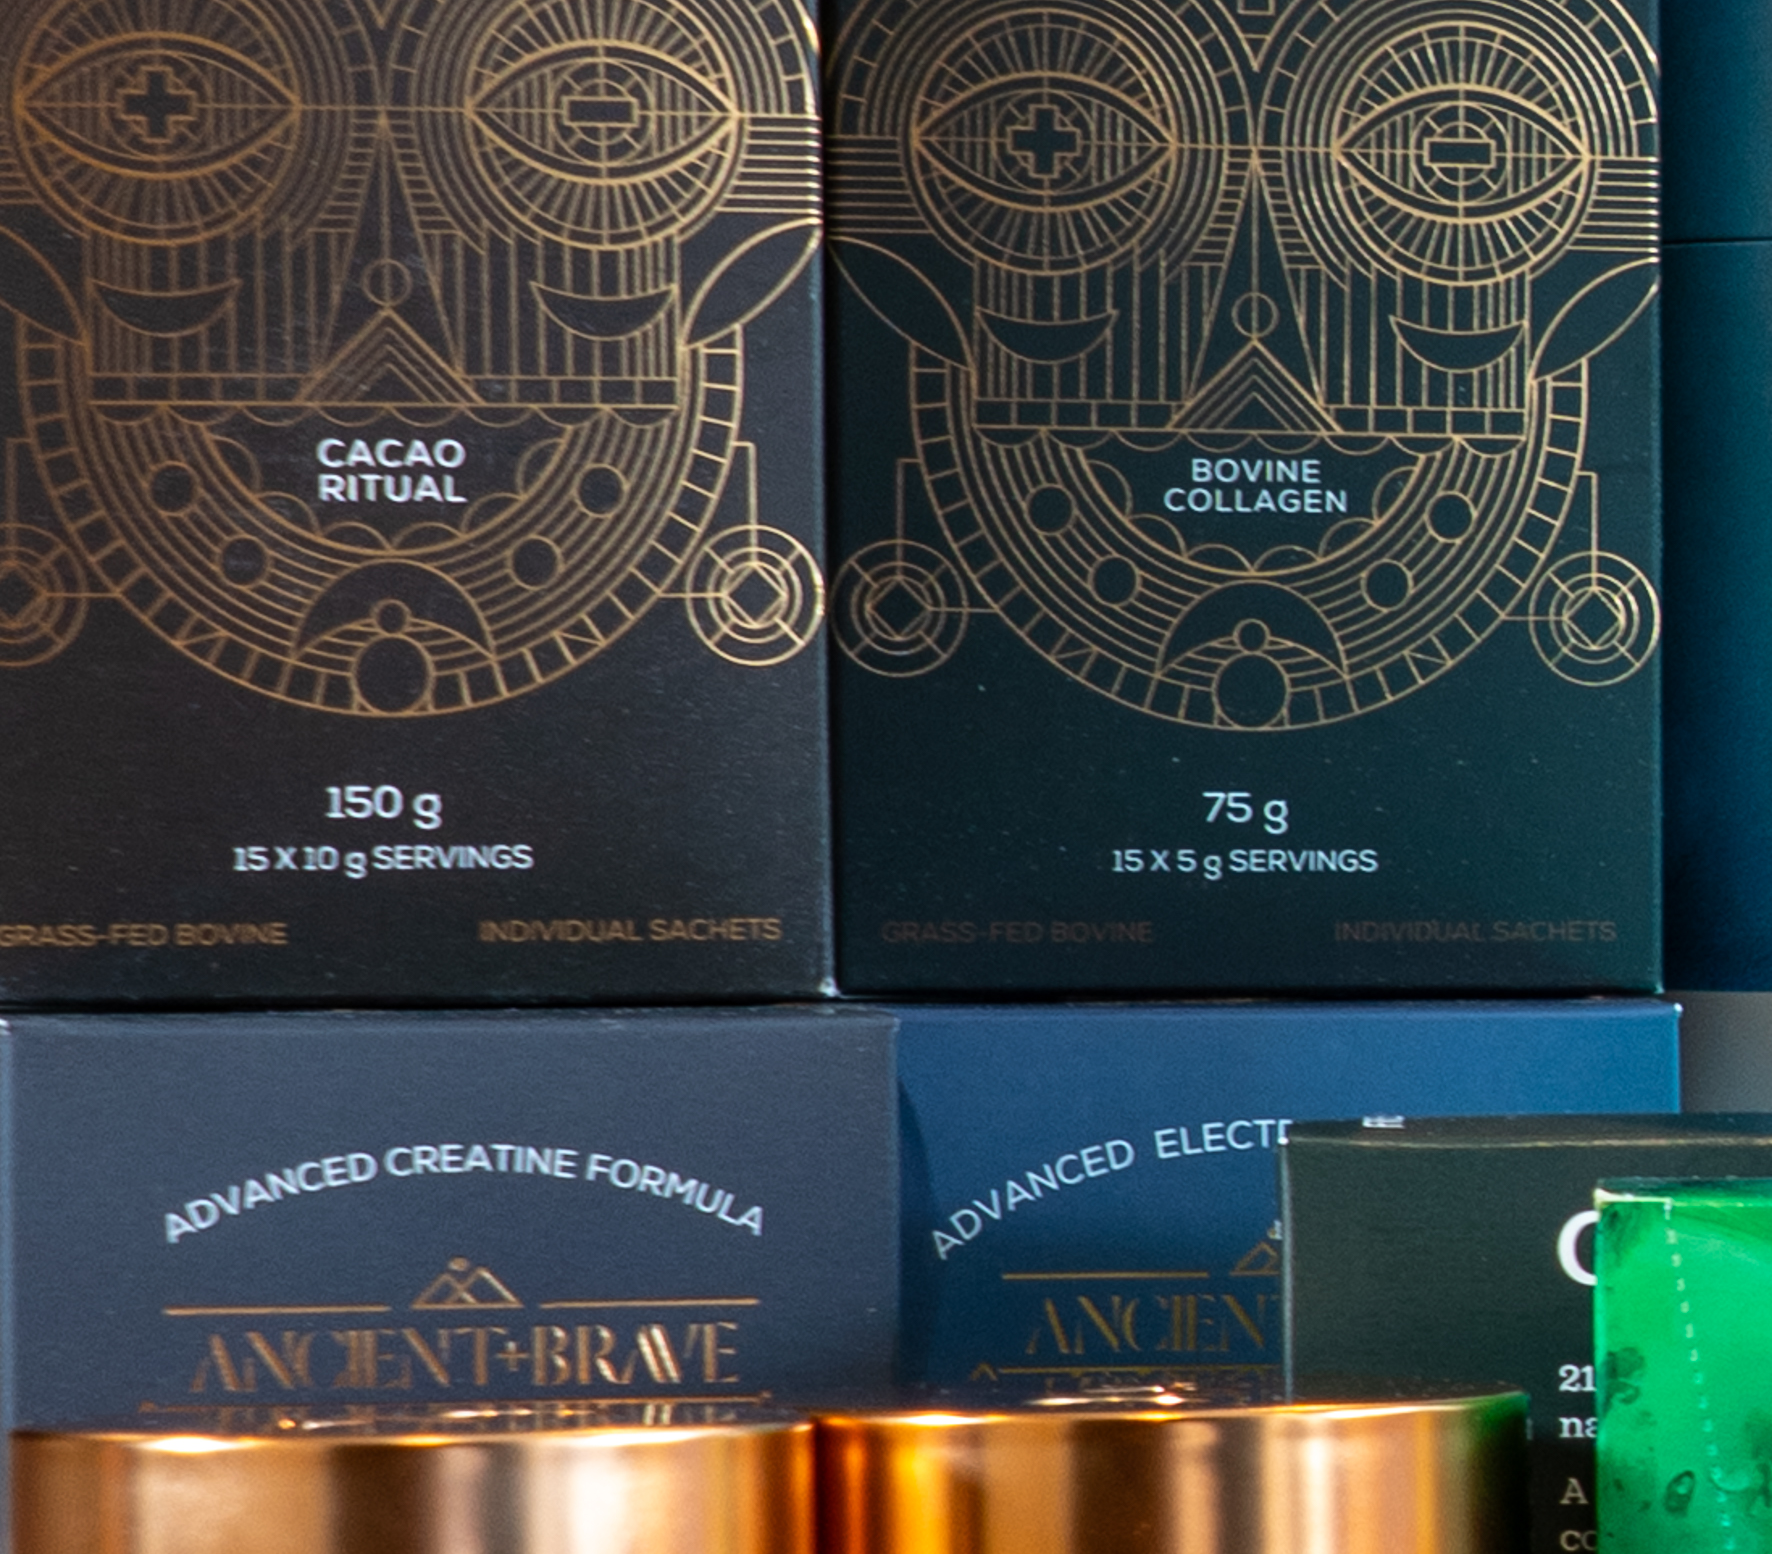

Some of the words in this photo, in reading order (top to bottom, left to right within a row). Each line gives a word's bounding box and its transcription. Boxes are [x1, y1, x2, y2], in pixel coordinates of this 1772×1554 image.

[317, 439, 466, 468] CACAO
[1191, 458, 1321, 484] BOVINE
[318, 474, 467, 504] RITUAL
[1163, 487, 1348, 514] COLLAGEN
[325, 785, 403, 821] 150
[1202, 791, 1253, 823] 75
[373, 845, 534, 871] SERVINGS
[1229, 849, 1378, 874] SERVINGS
[478, 918, 643, 944] INDIVIDUAL
[649, 916, 782, 943] SACHETS
[1335, 920, 1484, 944] INDIVIDUAL
[1495, 920, 1616, 944] SACHETS
[163, 1151, 378, 1244] ADVANCED
[384, 1143, 578, 1180] CREATINE
[585, 1153, 764, 1236] FORMULA
[931, 1139, 1135, 1260] ADVANCED
